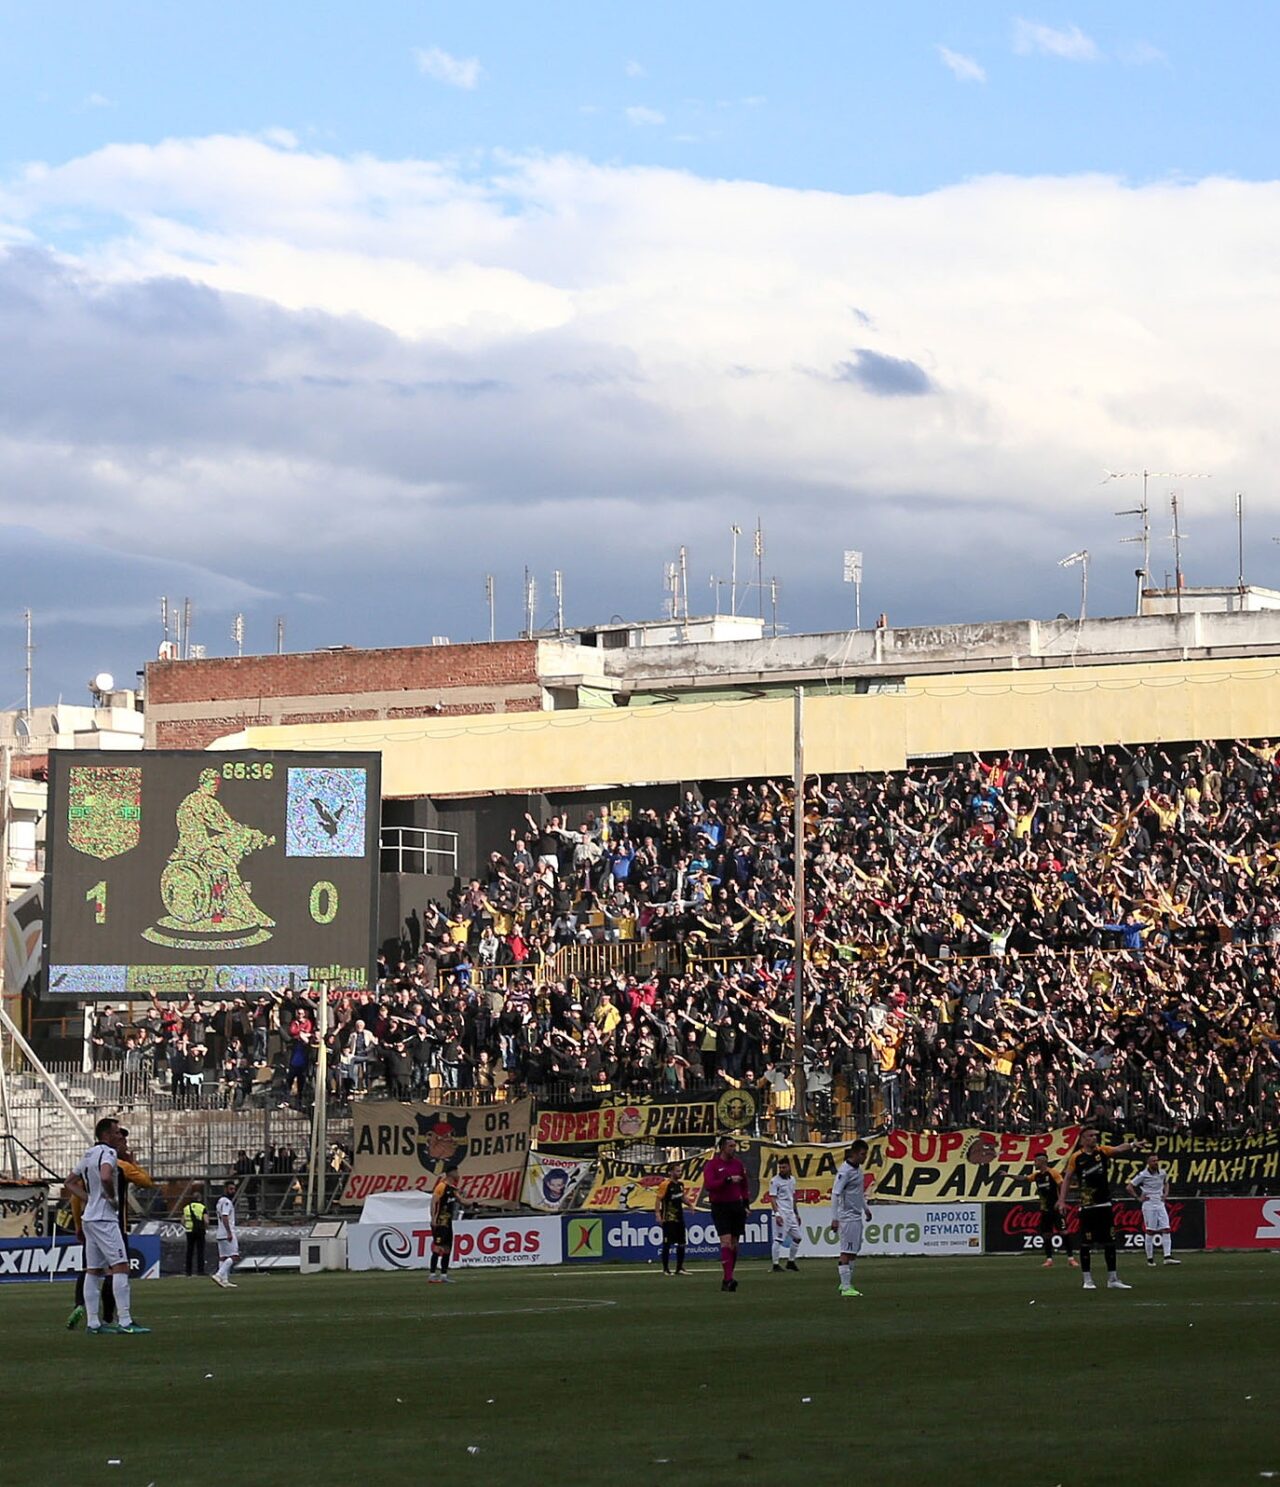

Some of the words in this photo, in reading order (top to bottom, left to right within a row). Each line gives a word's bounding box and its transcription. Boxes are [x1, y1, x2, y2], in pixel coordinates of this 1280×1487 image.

[86, 881, 107, 924] 1
[309, 880, 339, 924] 0
[538, 1110, 600, 1142] SUPER
[603, 1109, 615, 1138] 3
[645, 1104, 716, 1134] PEREA
[357, 1125, 416, 1155] ARIS
[485, 1112, 510, 1131] OR
[470, 1132, 526, 1156] DEATH
[926, 1211, 976, 1222] ΠΑΡΟΧΟΣ
[923, 1223, 979, 1235] ΡΕΥΜΑΤΟΣ
[1023, 1234, 1063, 1248] zeo
[1124, 1234, 1163, 1247] zeo
[461, 1253, 540, 1264] www.topgas.com.gr
